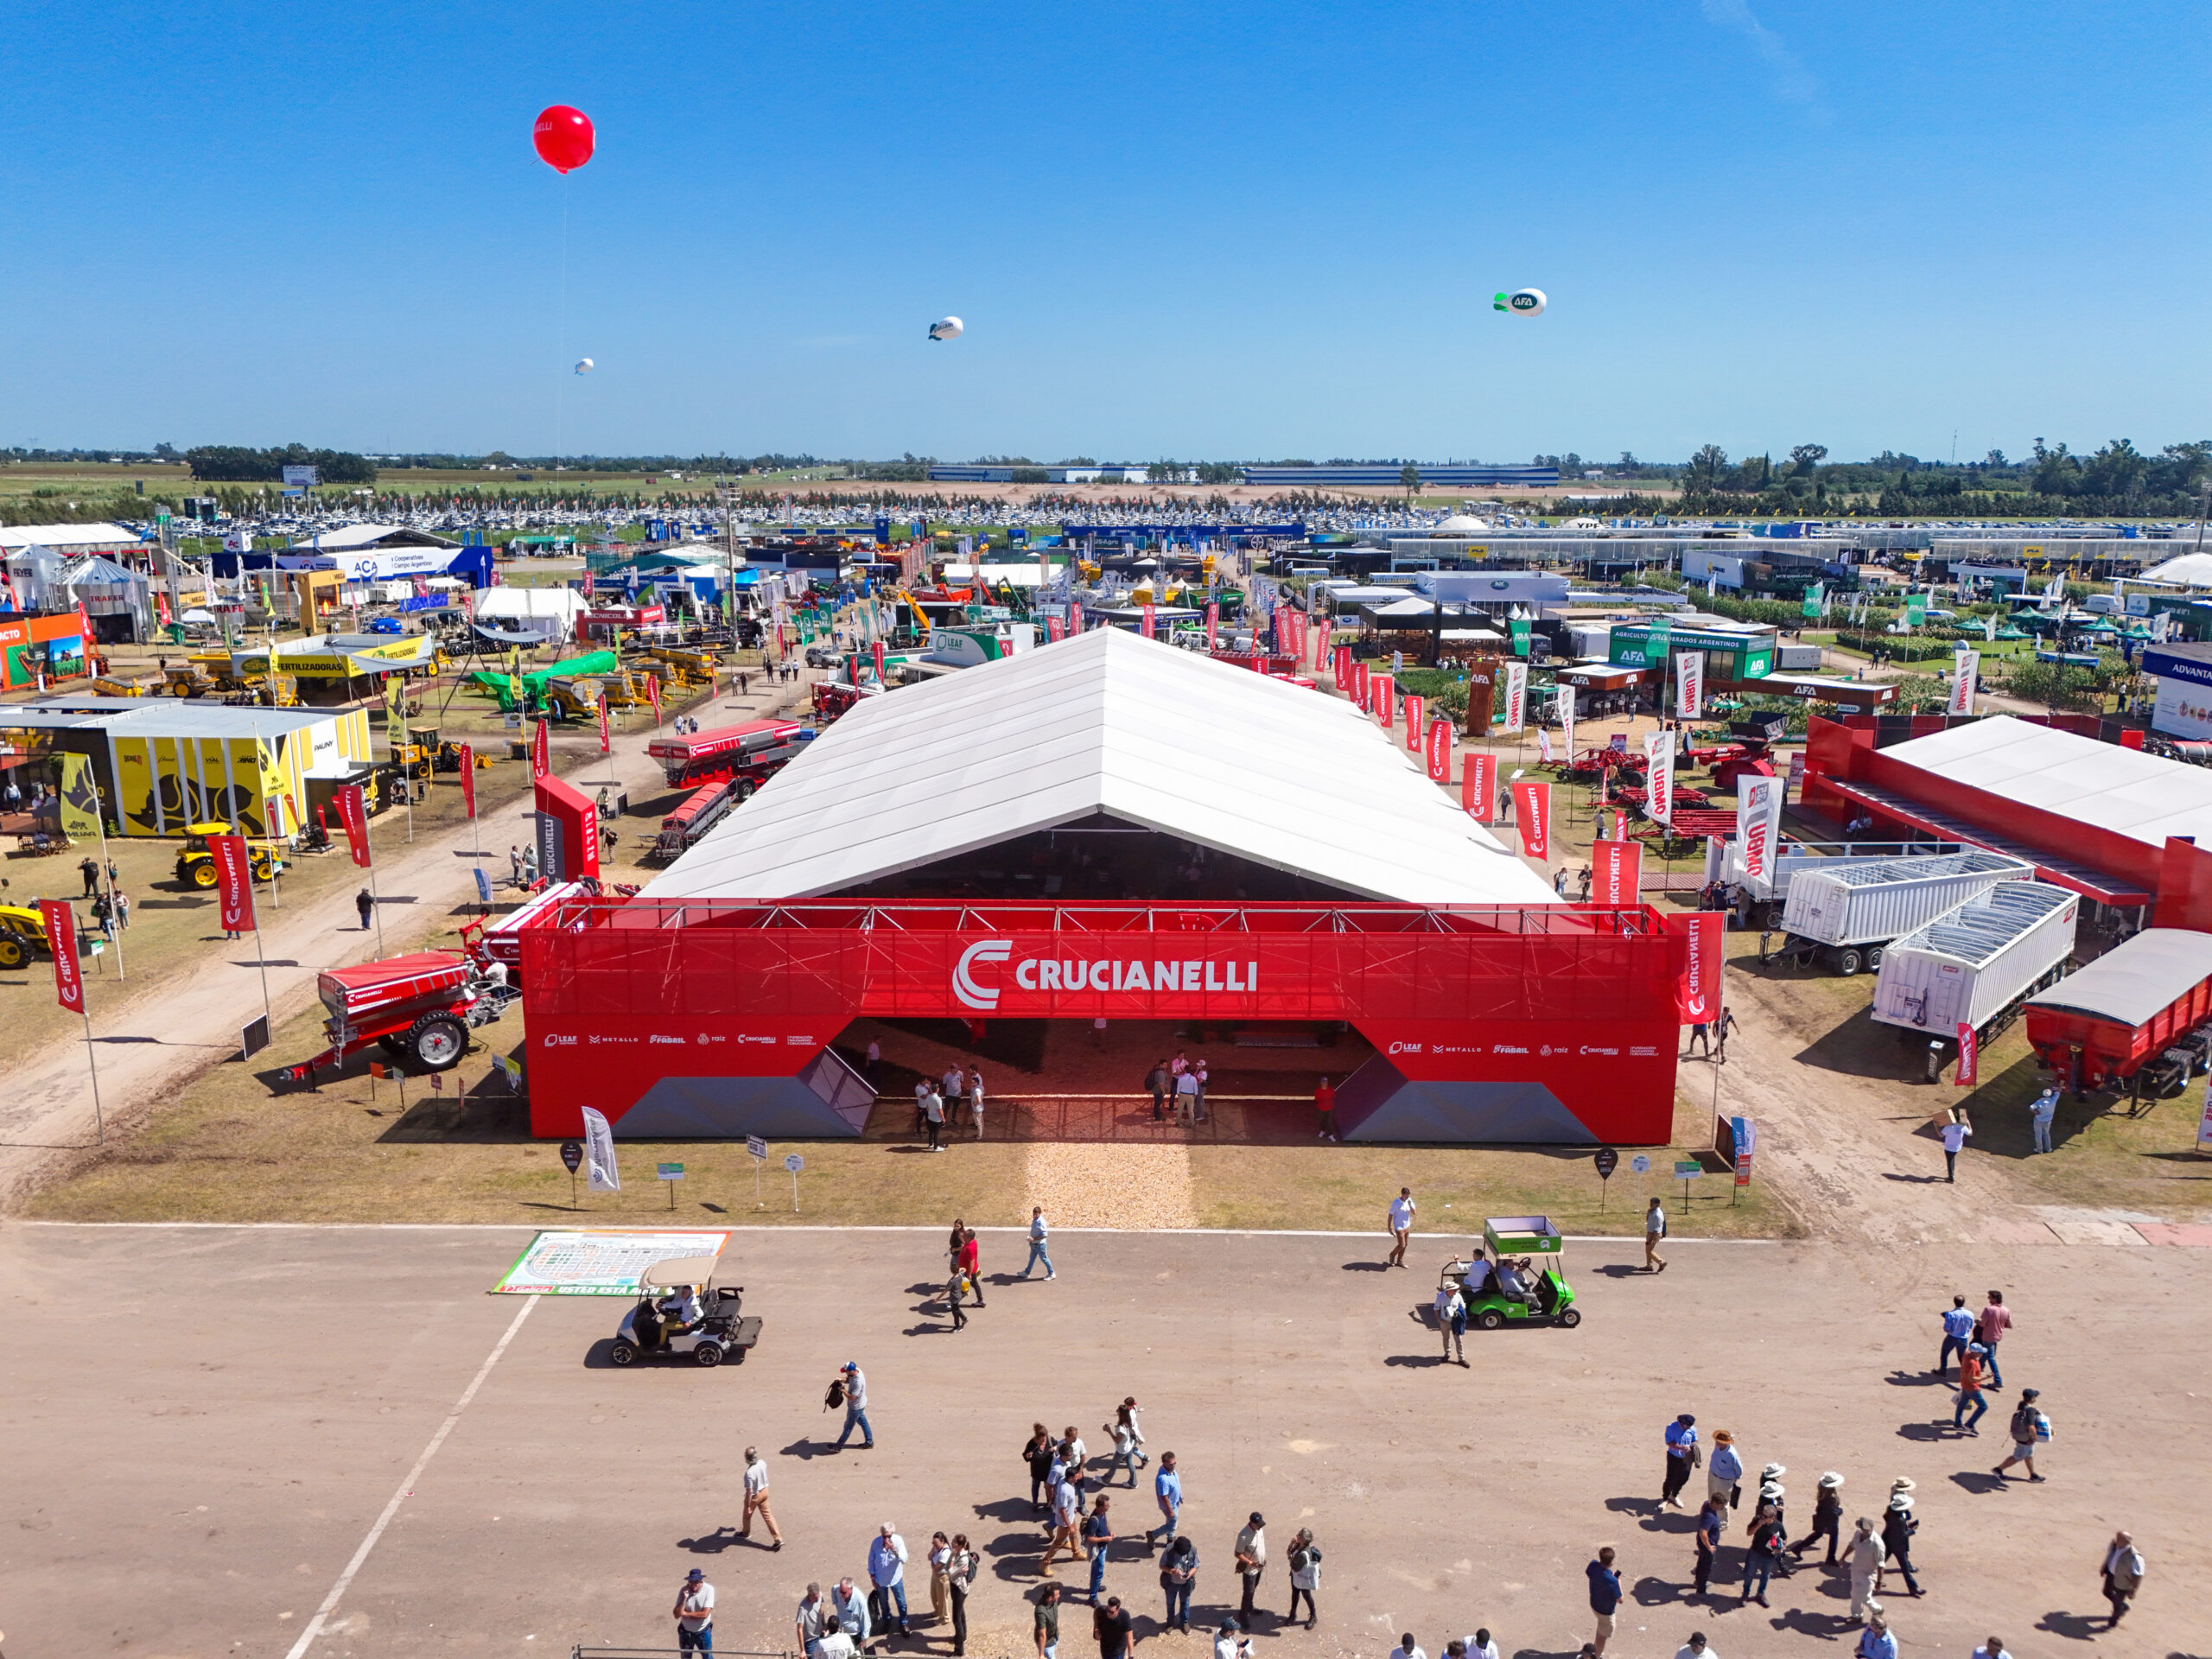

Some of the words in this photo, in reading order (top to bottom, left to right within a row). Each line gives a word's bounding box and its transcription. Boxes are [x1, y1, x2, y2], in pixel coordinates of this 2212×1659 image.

[1514, 297, 1533, 305] AFA
[354, 561, 378, 573] ACA
[334, 572, 346, 581] MEGA
[90, 594, 124, 603] TRAFER
[947, 638, 963, 648] LEAF
[1699, 639, 1739, 648] ARGENTINOS
[1620, 650, 1646, 662] AFA
[277, 663, 343, 671] FERTILIZADORAS
[1750, 659, 1764, 672] AFA
[1471, 674, 1489, 684] AFA
[1570, 675, 1590, 685] AFA
[1626, 674, 1637, 684] AFA
[1794, 685, 1817, 696] AFA
[1881, 690, 1893, 701] AFA
[314, 740, 334, 752] PAUNY
[1016, 959, 1257, 991] CRUCIANELLI
[355, 989, 382, 1000] CRUCIANELLI
[598, 1284, 628, 1294] ESTÁ
